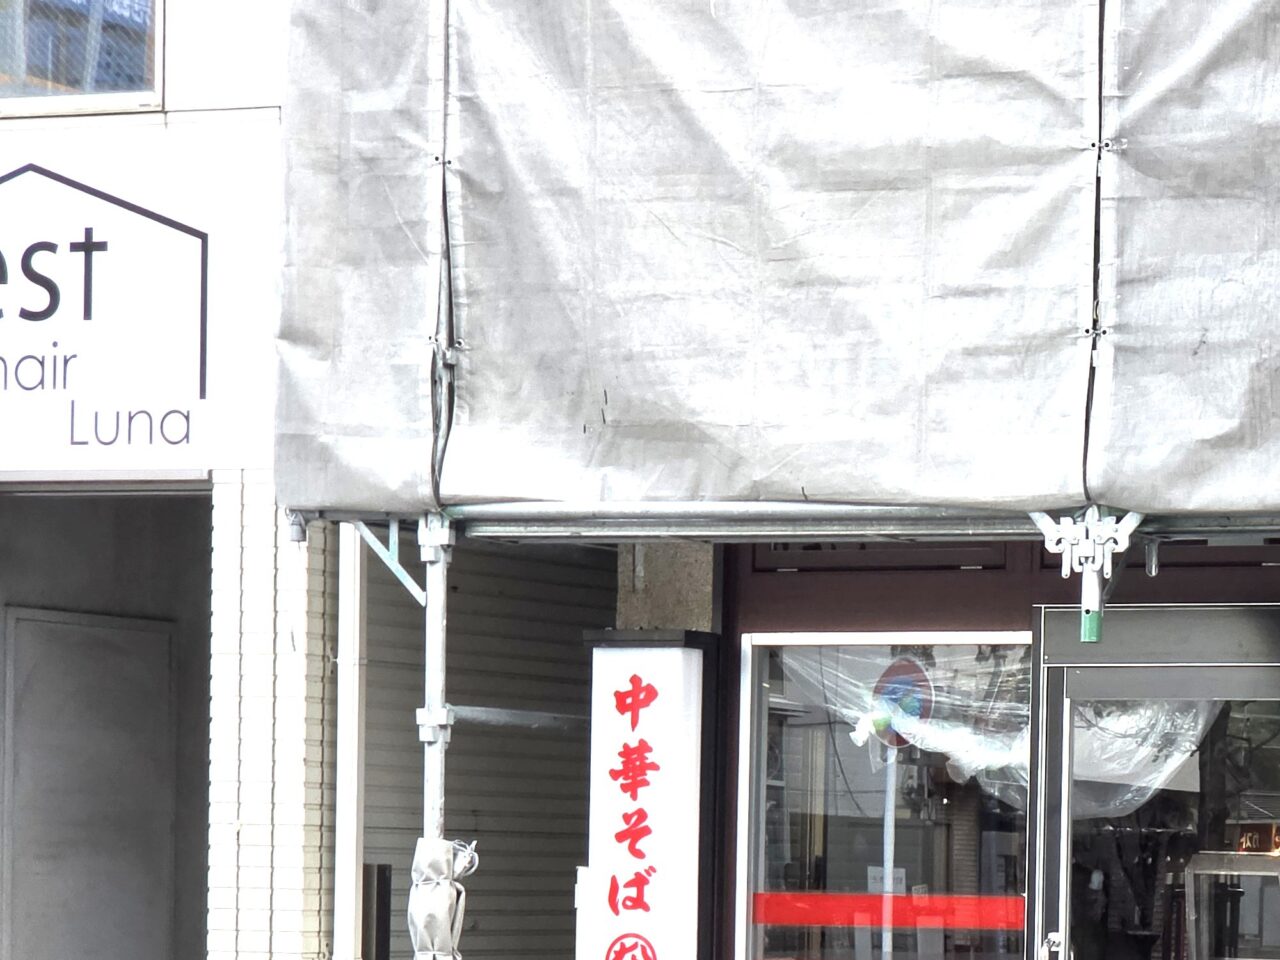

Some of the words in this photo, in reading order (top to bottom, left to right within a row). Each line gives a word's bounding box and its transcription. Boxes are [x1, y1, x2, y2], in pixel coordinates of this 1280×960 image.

[0, 226, 108, 322] st
[70, 399, 190, 446] Luna
[607, 674, 660, 916] 中華そば
